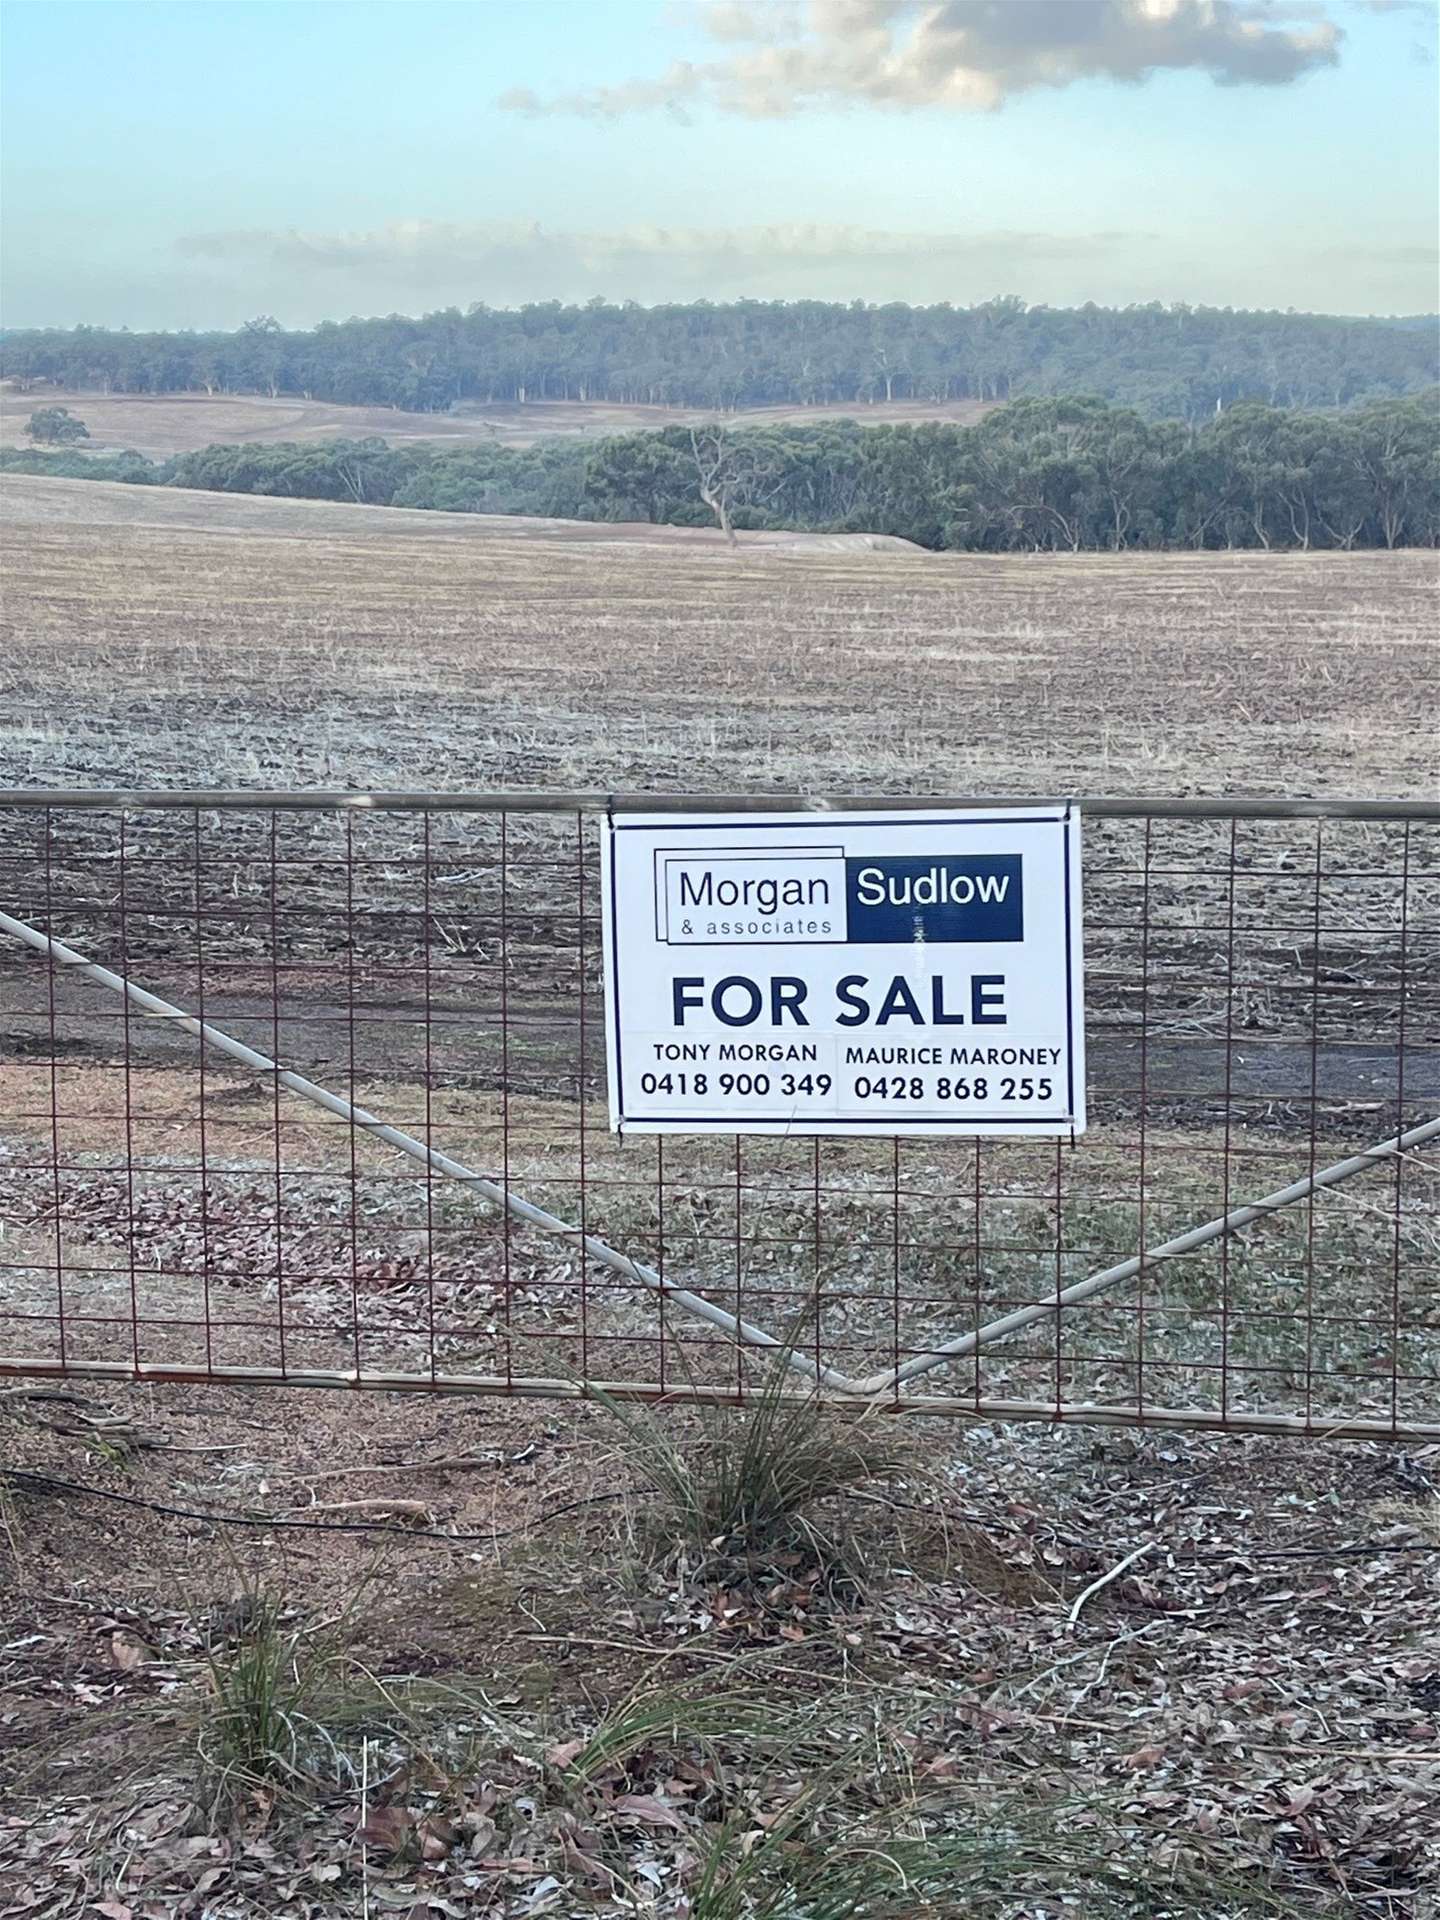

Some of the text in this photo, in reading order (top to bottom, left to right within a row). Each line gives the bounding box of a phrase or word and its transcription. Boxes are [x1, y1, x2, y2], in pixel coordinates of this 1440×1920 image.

[680, 867, 1009, 915] Morgan Sudlow
[681, 918, 831, 935] & associates
[672, 974, 1007, 1027] FOR SALE
[654, 1044, 817, 1062] TONY MORGAN
[845, 1047, 1062, 1065] MAURICE MARONEY
[641, 1073, 832, 1096] 0418 900 349
[854, 1077, 1053, 1100] 0428 868 255
